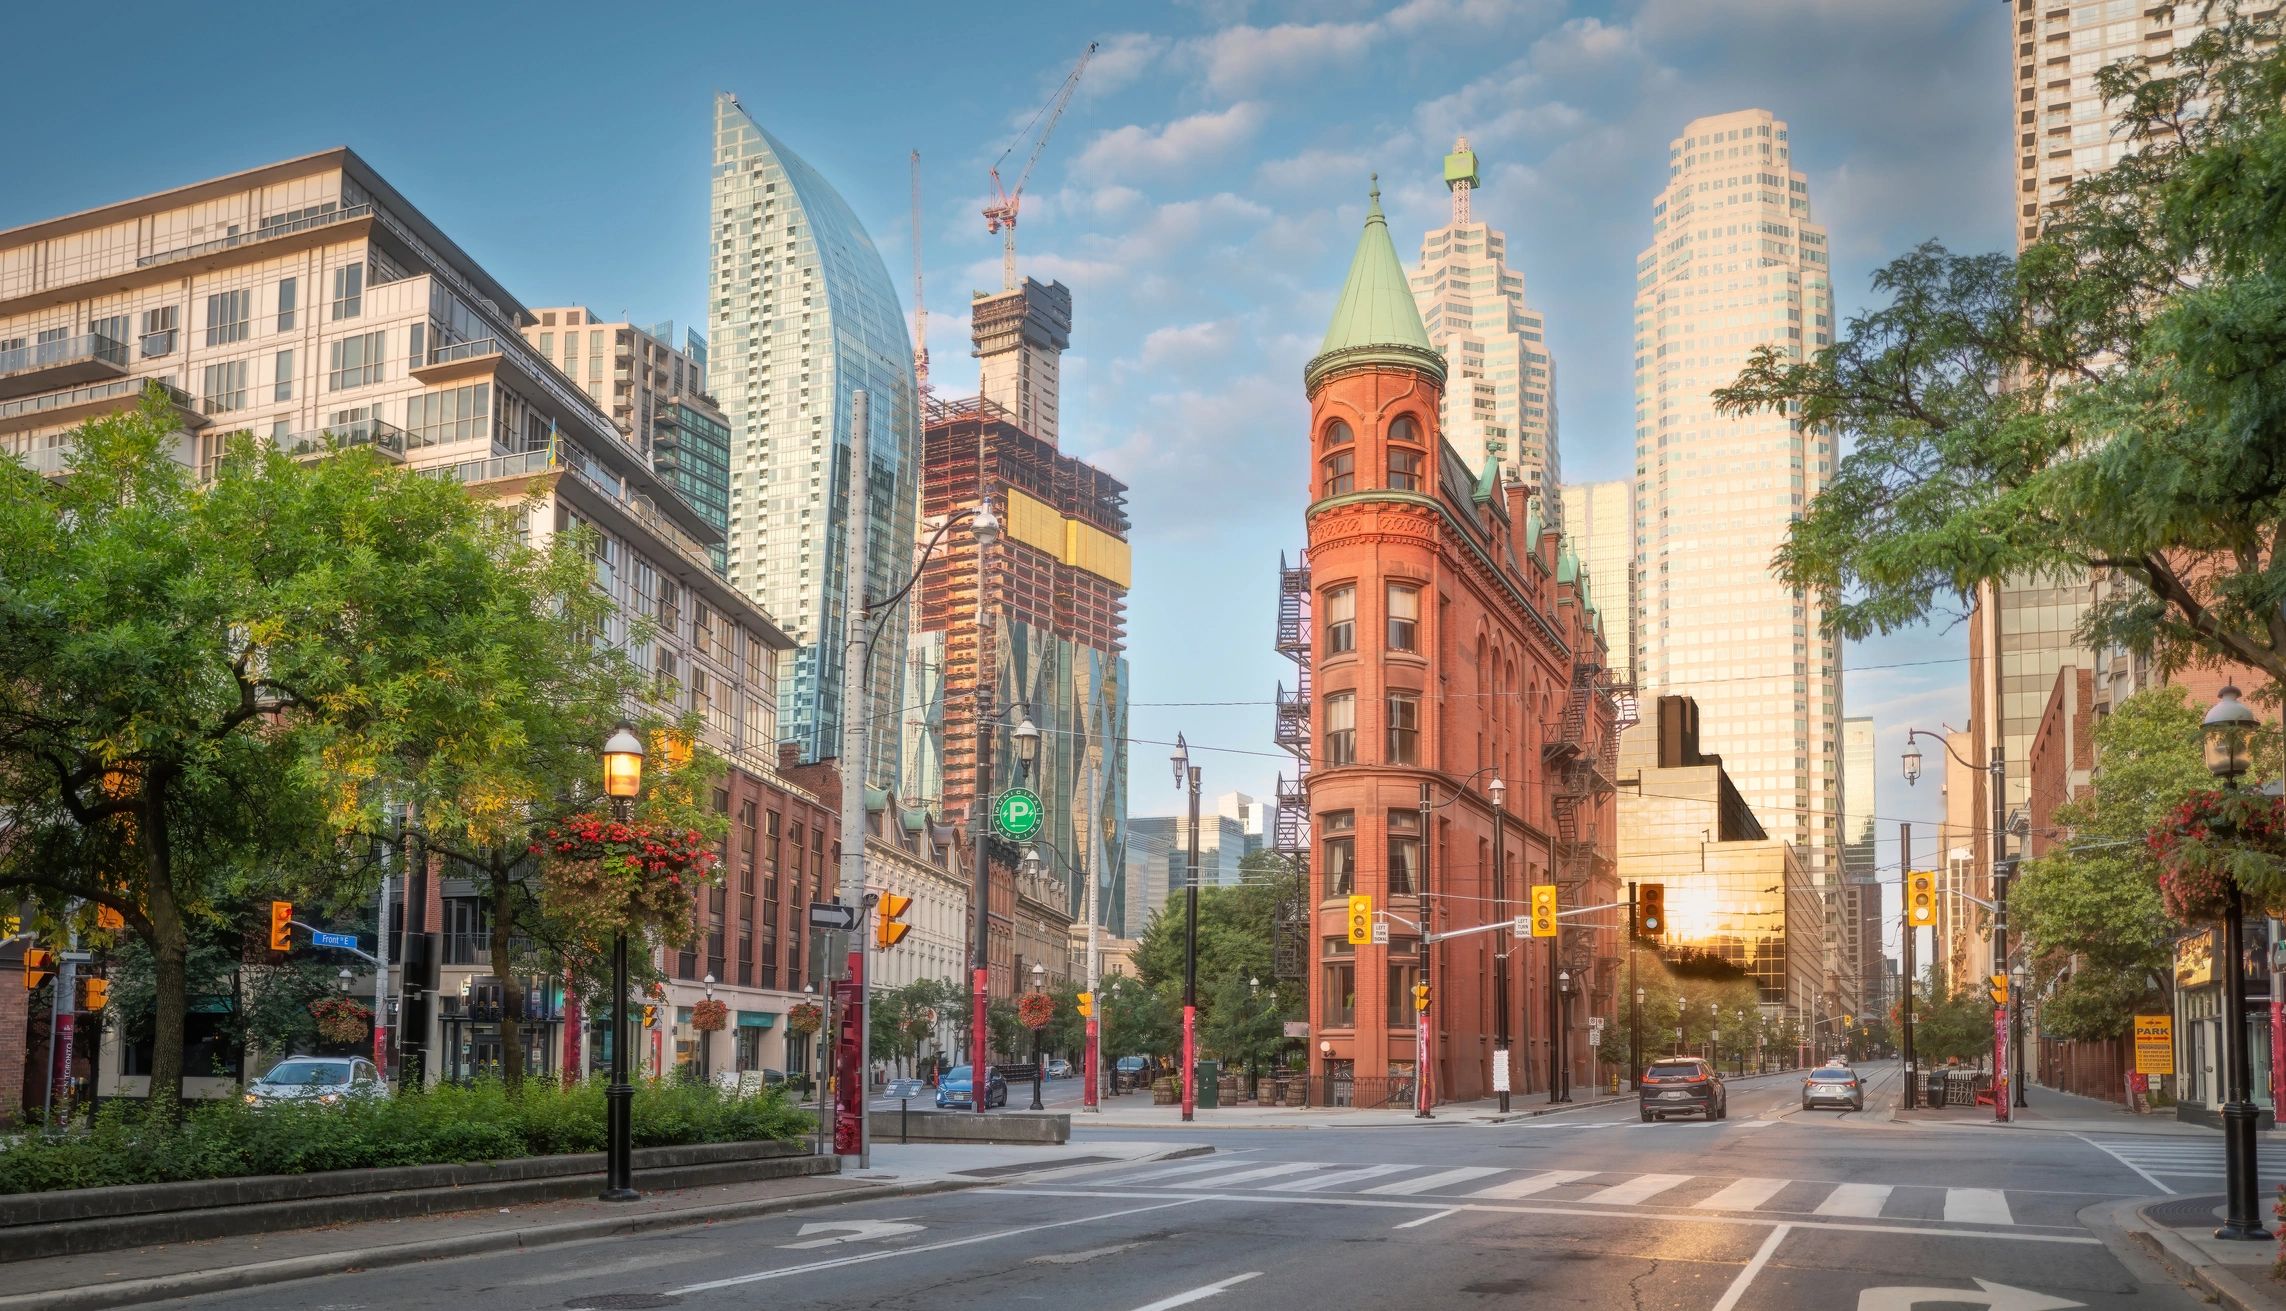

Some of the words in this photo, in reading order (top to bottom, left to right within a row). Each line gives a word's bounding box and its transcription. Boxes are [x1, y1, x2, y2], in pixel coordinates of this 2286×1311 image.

[995, 790, 1040, 813] MUNICIPAL
[1009, 801, 1029, 823] P
[995, 819, 1041, 839] PARKING
[322, 934, 339, 944] Front
[344, 937, 349, 945] E
[2137, 1027, 2169, 1035] PARK
[64, 1043, 73, 1078] TORONTO
